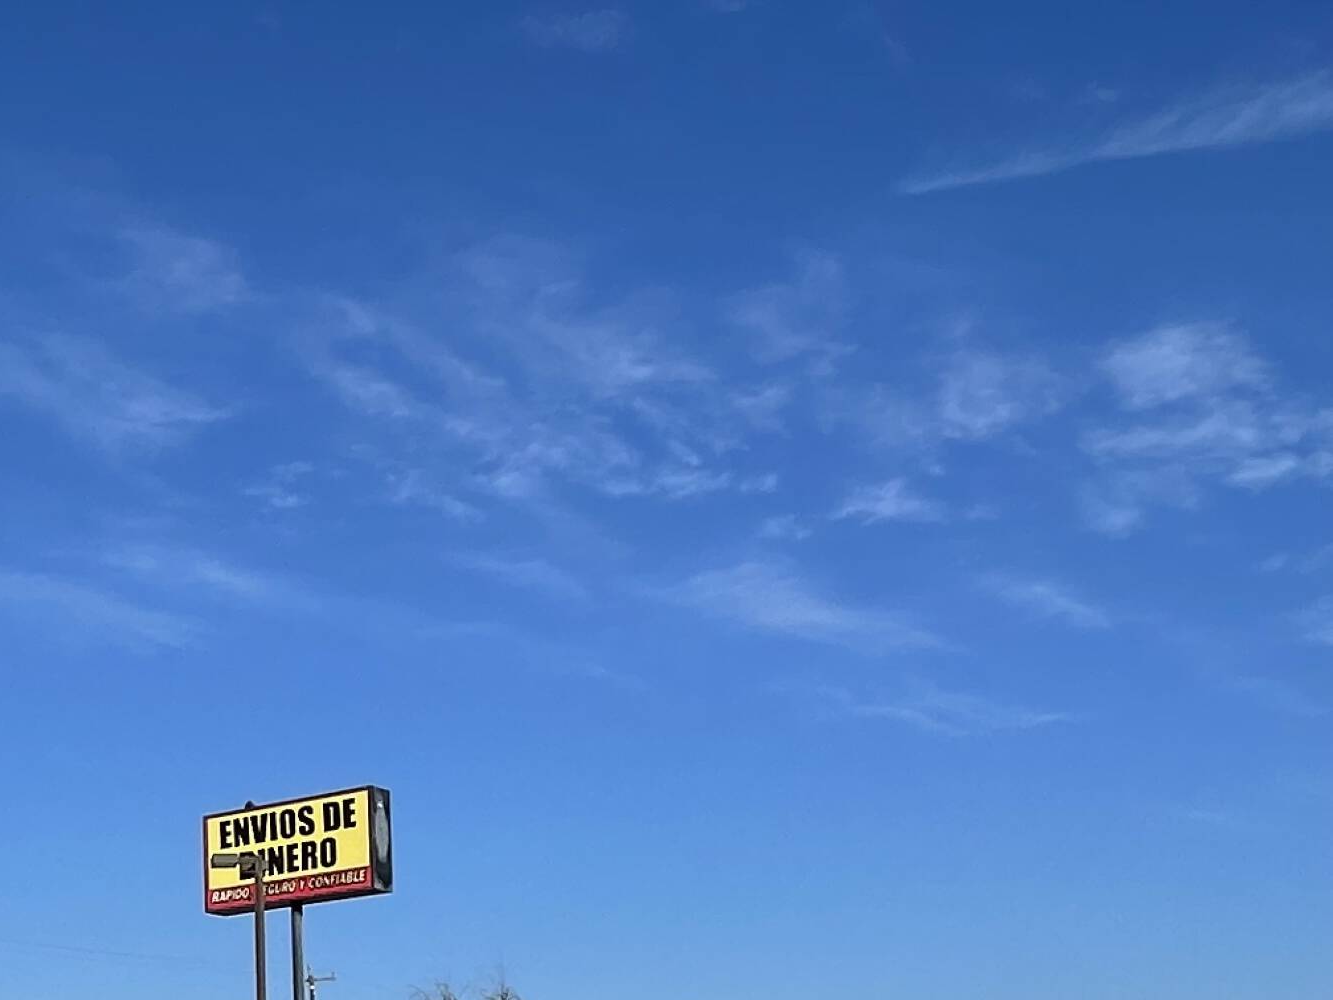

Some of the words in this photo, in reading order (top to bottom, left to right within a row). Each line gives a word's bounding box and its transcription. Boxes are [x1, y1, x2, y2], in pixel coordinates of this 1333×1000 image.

[219, 806, 316, 850] ENVIOS
[323, 798, 357, 834] DE
[261, 880, 296, 896] EGURO
[307, 869, 366, 889] CONFIABLE
